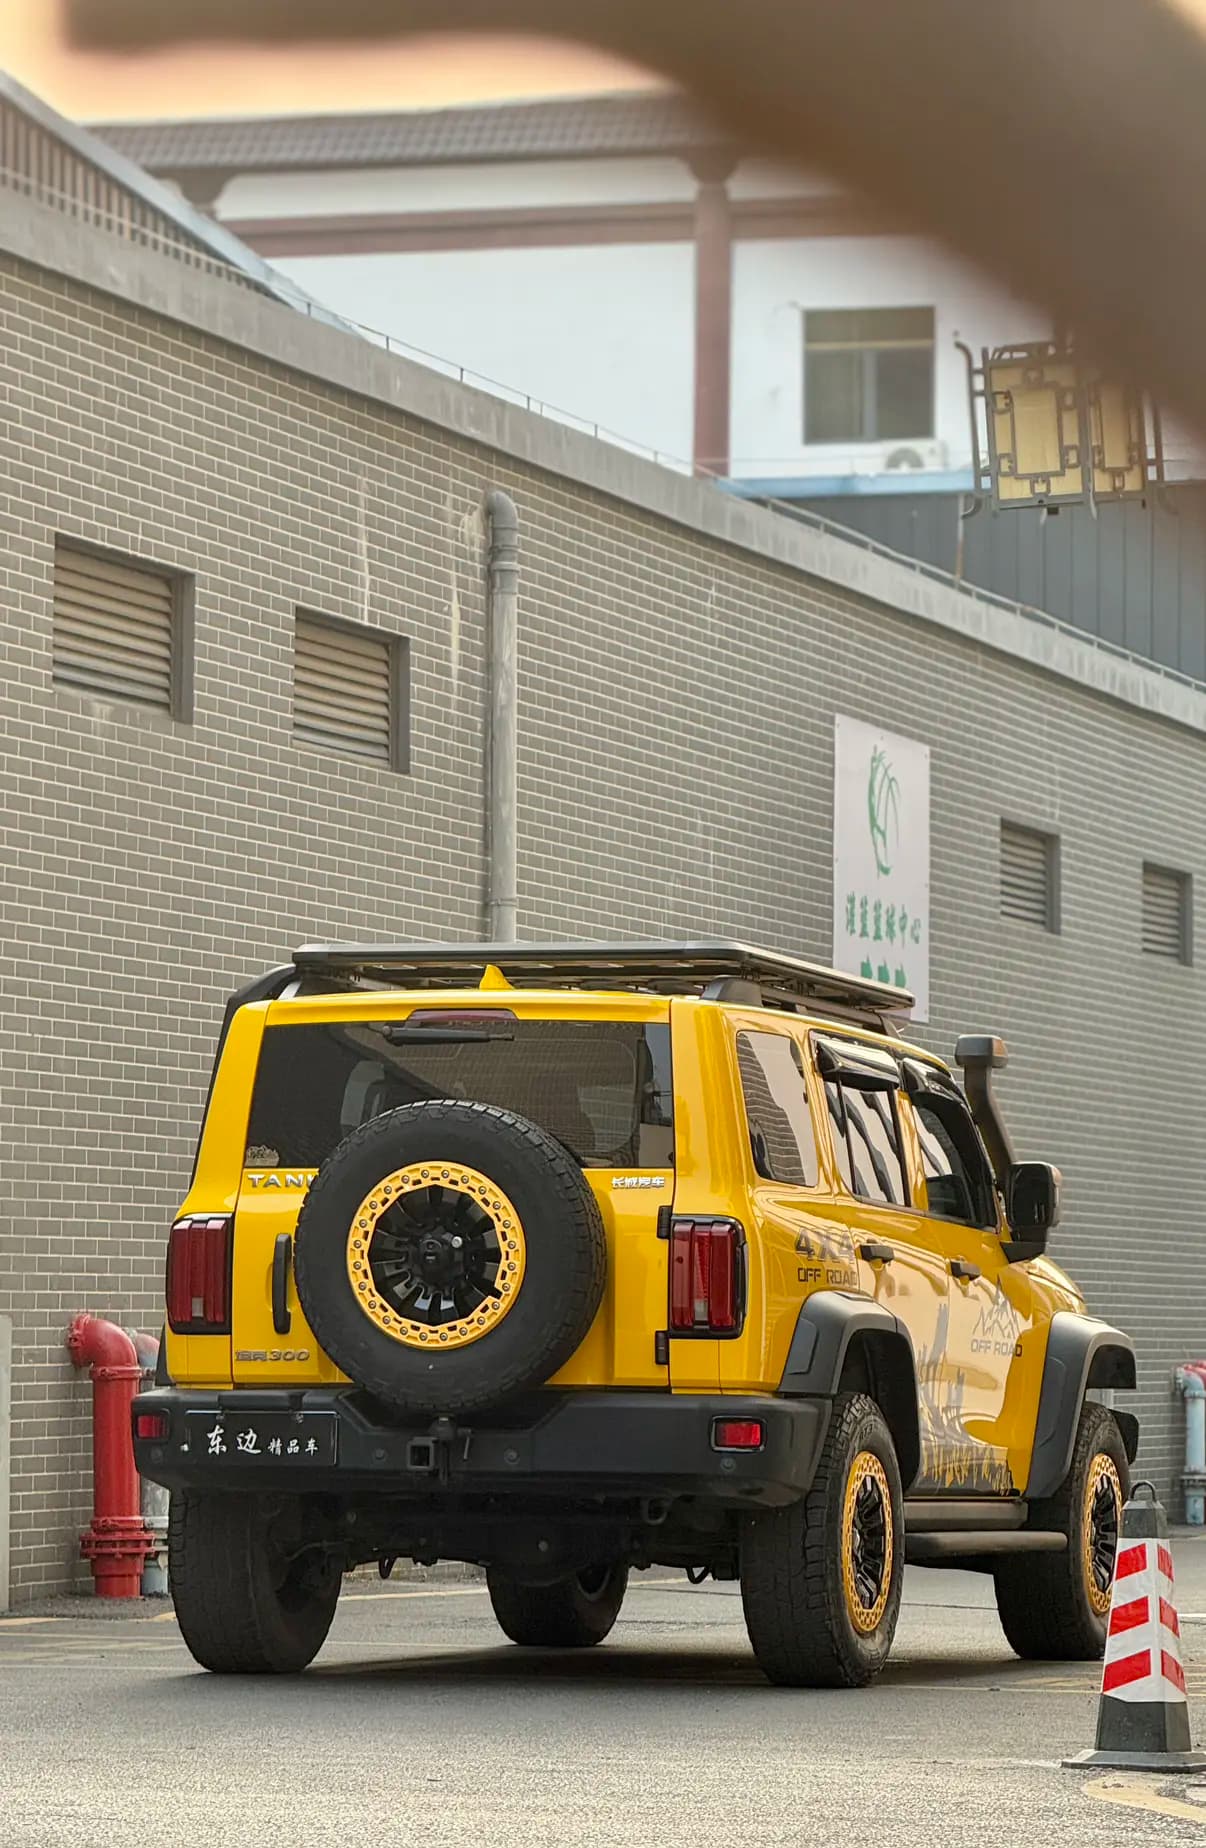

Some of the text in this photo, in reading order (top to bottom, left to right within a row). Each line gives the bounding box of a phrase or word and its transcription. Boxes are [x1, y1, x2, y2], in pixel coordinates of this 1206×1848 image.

[611, 1176, 665, 1189] 长城汽车
[795, 1227, 856, 1263] 4X4
[797, 1267, 858, 1286] OFF ROAD
[970, 1338, 1023, 1357] OFF ROAD
